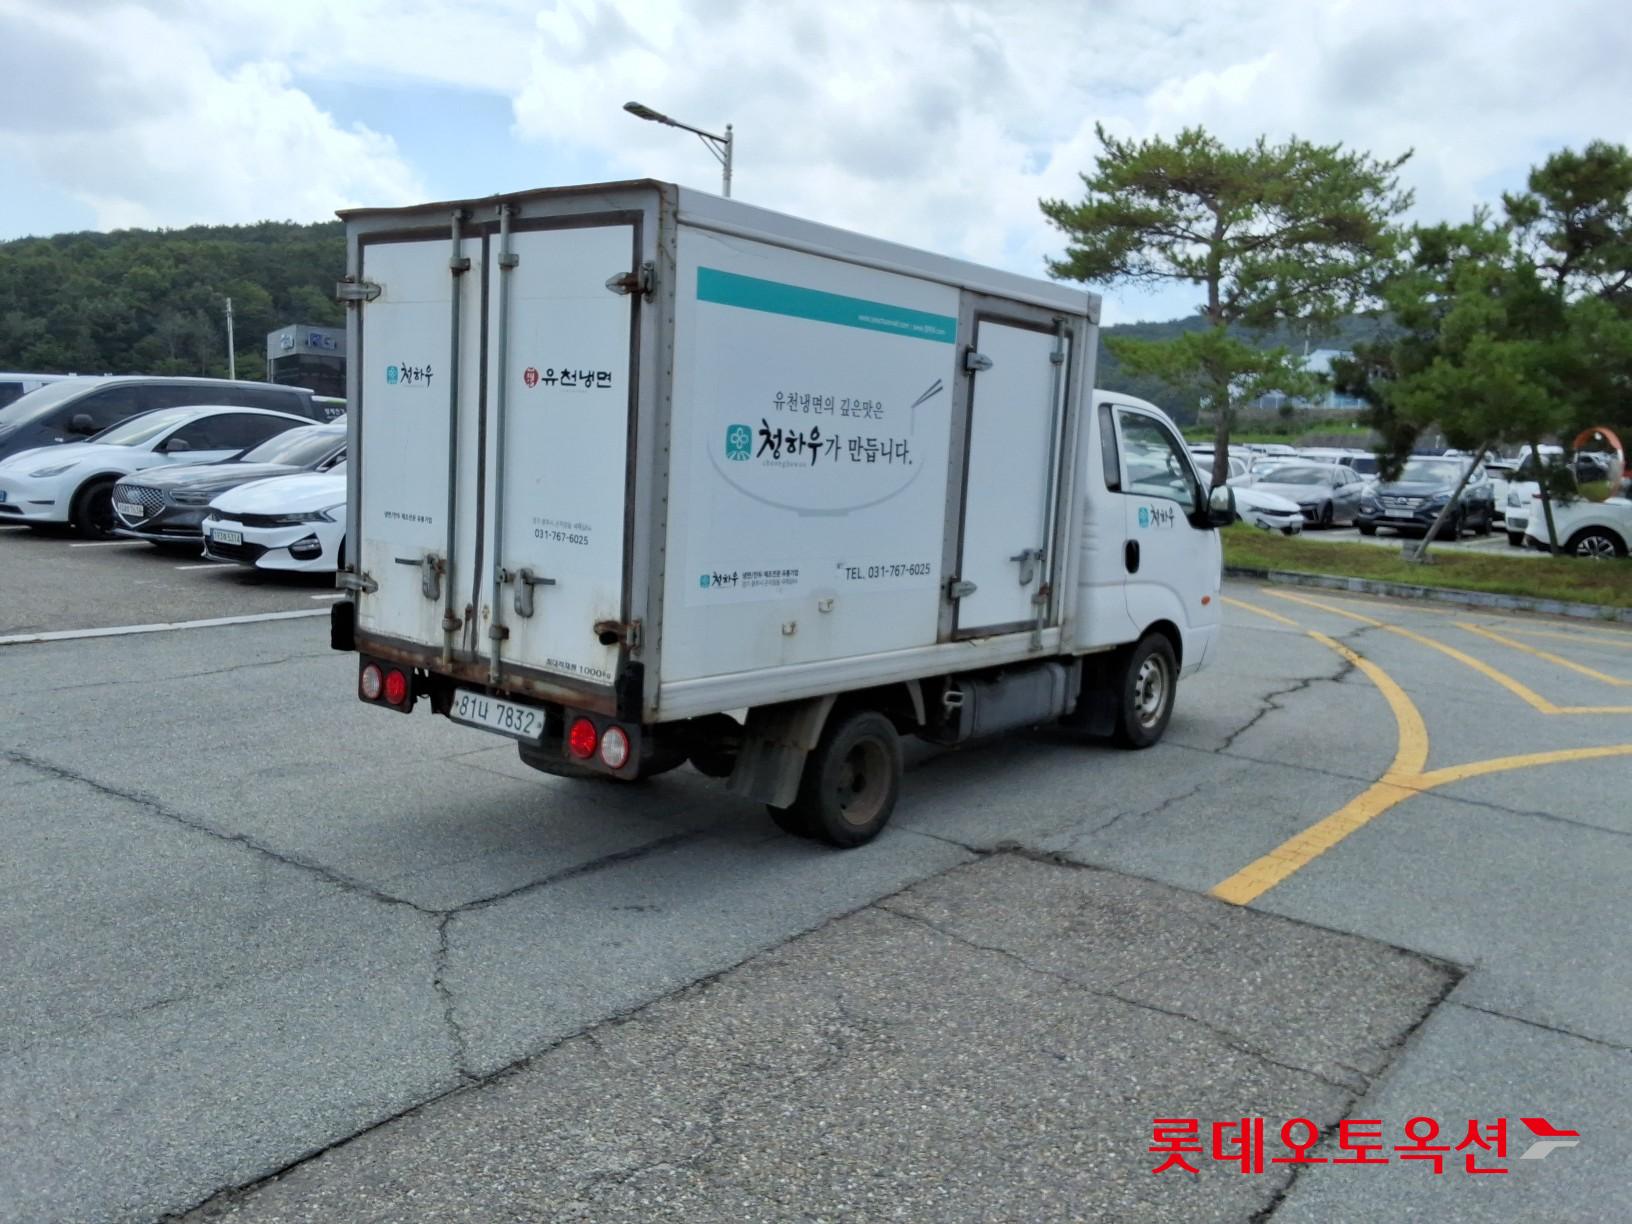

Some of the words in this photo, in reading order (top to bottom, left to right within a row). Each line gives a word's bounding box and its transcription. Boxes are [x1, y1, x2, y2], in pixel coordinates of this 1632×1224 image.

[400, 362, 434, 388] 청하우
[541, 368, 612, 388] 유천냉면
[773, 391, 835, 415] 유천냉면의
[840, 398, 884, 420] 깊은맛은
[756, 417, 842, 467] 청하우가
[848, 434, 913, 465] 만듭니다.
[1150, 504, 1175, 528] 청하우
[534, 528, 589, 545] 031-767-6025
[845, 567, 866, 581] TEL.
[868, 562, 931, 578] 031-767-6025
[459, 695, 489, 722] 81나
[496, 704, 536, 734] 7832
